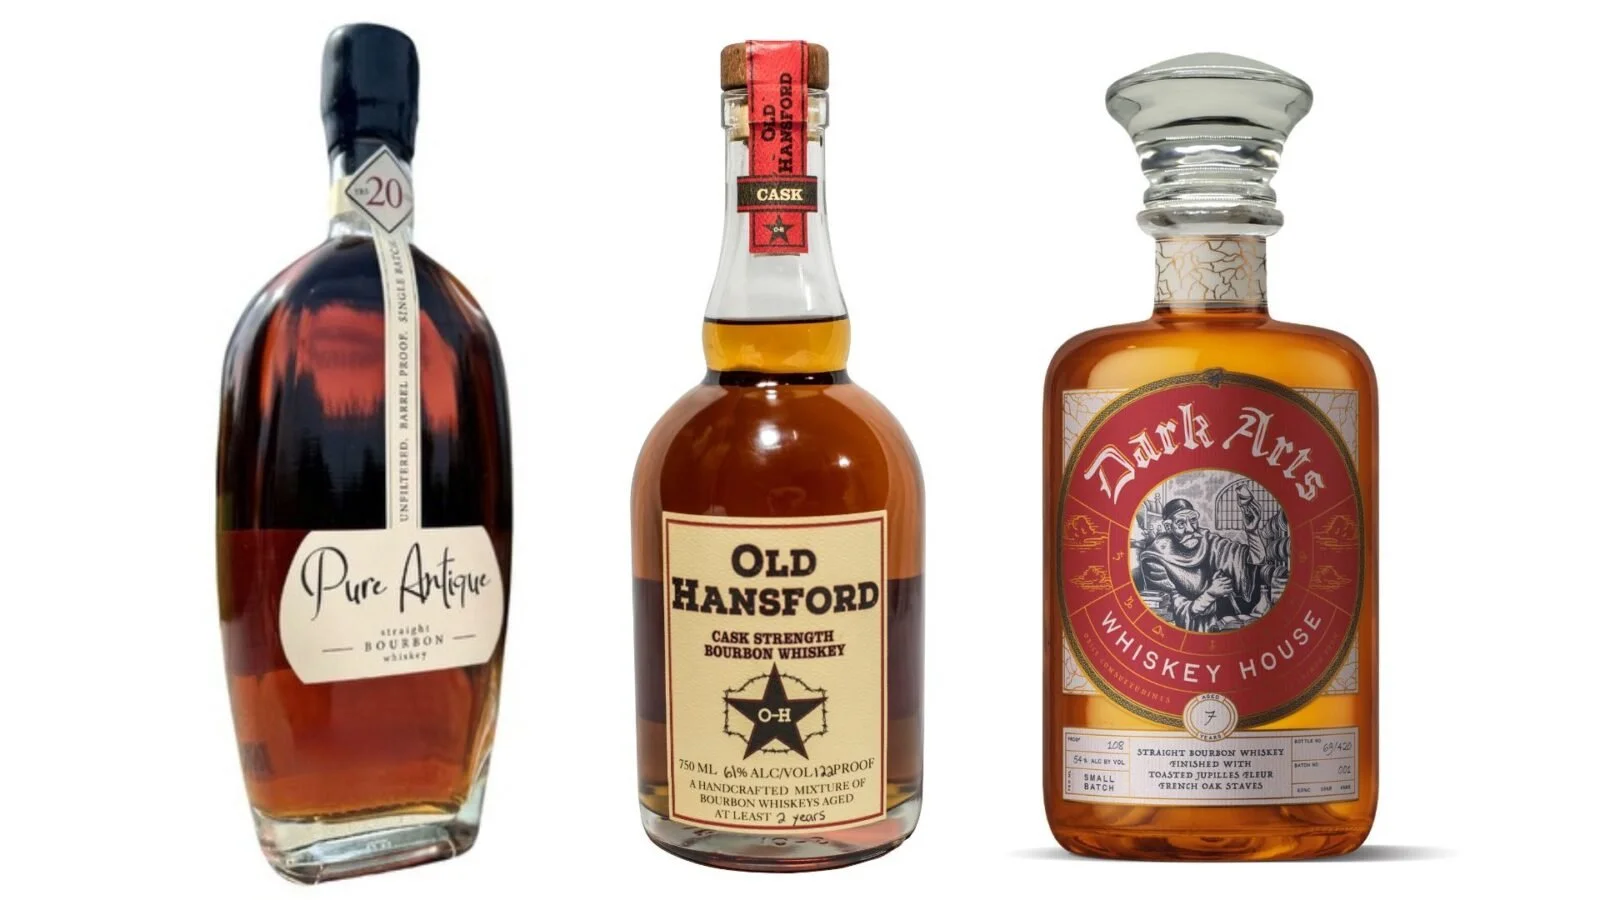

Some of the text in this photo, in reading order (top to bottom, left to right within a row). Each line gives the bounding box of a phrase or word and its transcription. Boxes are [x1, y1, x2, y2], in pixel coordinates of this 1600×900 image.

[761, 104, 776, 142] OLD
[778, 72, 793, 173] HANSFORD
[366, 176, 403, 208] 20
[756, 188, 803, 201] CASK
[394, 278, 408, 322] SINGLE
[399, 381, 409, 429] BARREL
[1083, 402, 1325, 504] Dark Arts
[731, 543, 817, 578] OLD
[301, 542, 491, 622] Pure Antique
[671, 576, 879, 616] HANSFORD
[380, 623, 430, 637] straight
[711, 630, 834, 645] CASK STRENGTH
[364, 634, 444, 652] BOURBON
[1101, 610, 1221, 684] WHISKEY
[1239, 609, 1322, 681] HOUSE
[383, 651, 427, 662] whiskey
[704, 643, 846, 660] BOURBON WHISKEY
[758, 708, 791, 723] O-H
[1204, 710, 1217, 726] 7
[1107, 740, 1125, 751] 108
[1137, 748, 1284, 757] STRAIGHT BOURBON WHISKEY
[1322, 741, 1353, 757] 69/420
[679, 759, 695, 771] 750
[697, 763, 718, 775] ML
[750, 767, 813, 780] ALC/VOL
[833, 758, 875, 775] PROOF
[1169, 760, 1252, 768] FINISHED WITH
[1083, 773, 1115, 783] SMALL
[1148, 771, 1274, 781] TOASTED JUPILLES FLEUR
[689, 777, 866, 796] A HANDCRAFTED MIXTURE OF
[1083, 782, 1115, 792] BATCH
[1158, 782, 1264, 790] FRENCH OAK STAVES
[700, 793, 854, 809] BOURBON WHISKEYS AGED
[714, 809, 826, 827] AT LEAST 2 years
